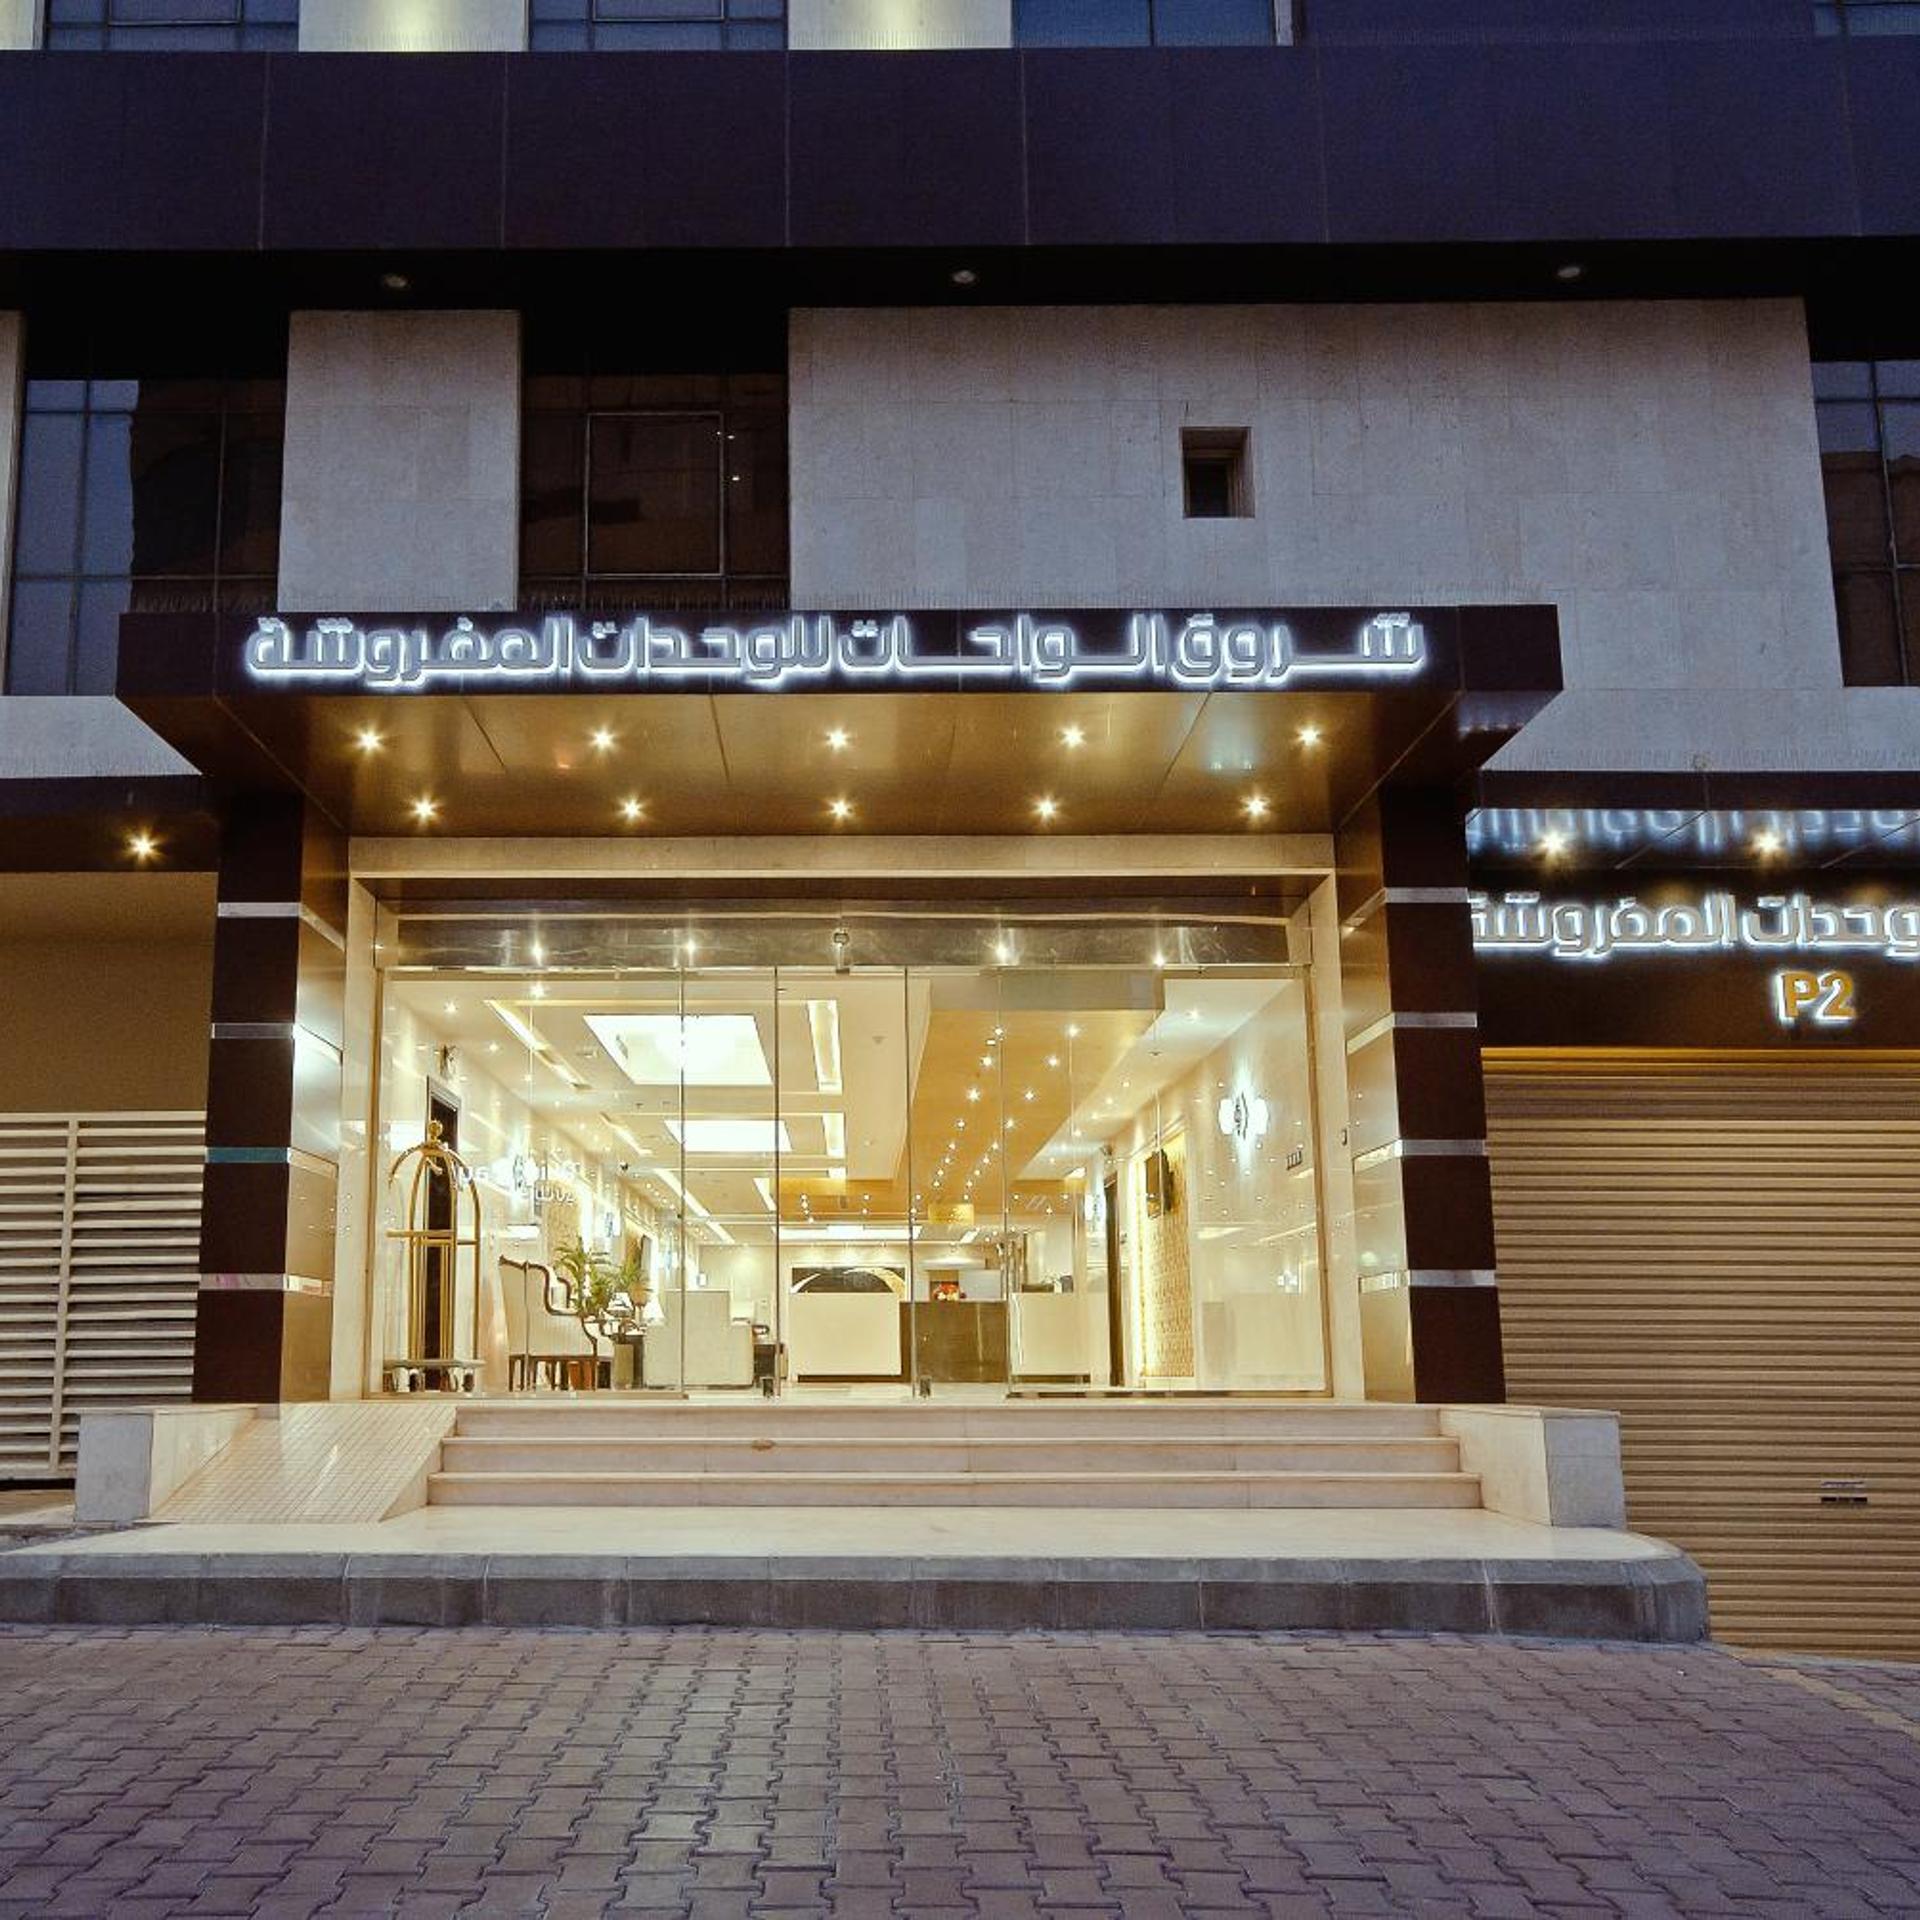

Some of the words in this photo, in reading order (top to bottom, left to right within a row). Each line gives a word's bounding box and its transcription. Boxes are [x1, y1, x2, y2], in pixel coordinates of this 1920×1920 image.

[246, 617, 573, 686] المفروشة
[577, 616, 832, 684] للوحدات
[839, 613, 1166, 683] الواحات
[1173, 612, 1424, 683] شروق
[1775, 969, 1856, 1023] P2
